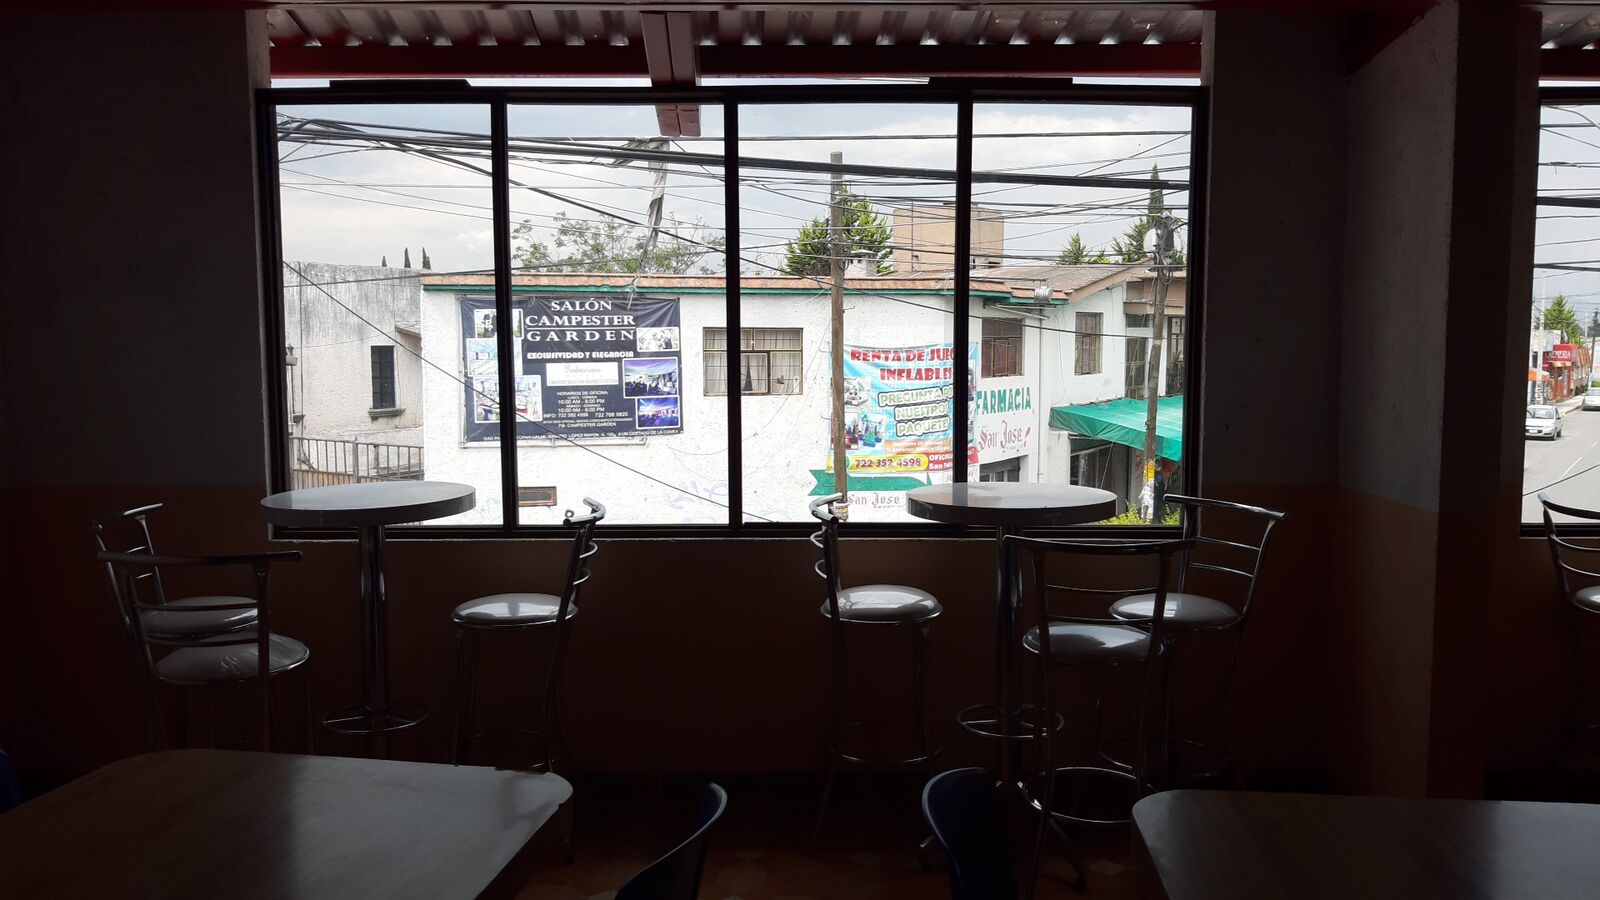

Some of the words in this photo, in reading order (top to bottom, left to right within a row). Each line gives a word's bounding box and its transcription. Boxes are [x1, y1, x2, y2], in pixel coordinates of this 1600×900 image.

[551, 298, 612, 311] SALÓN
[525, 315, 636, 326] CAMPESTER
[526, 330, 635, 341] GARDEN
[527, 352, 584, 360] EXCLUSIVIDAD
[850, 348, 903, 362] RENTA
[905, 349, 926, 362] DE
[880, 387, 942, 404] PREGUNTA
[976, 387, 1032, 415] FARMACIA
[855, 459, 873, 468] 722
[896, 457, 921, 467] 4598
[872, 491, 900, 506] Jose
